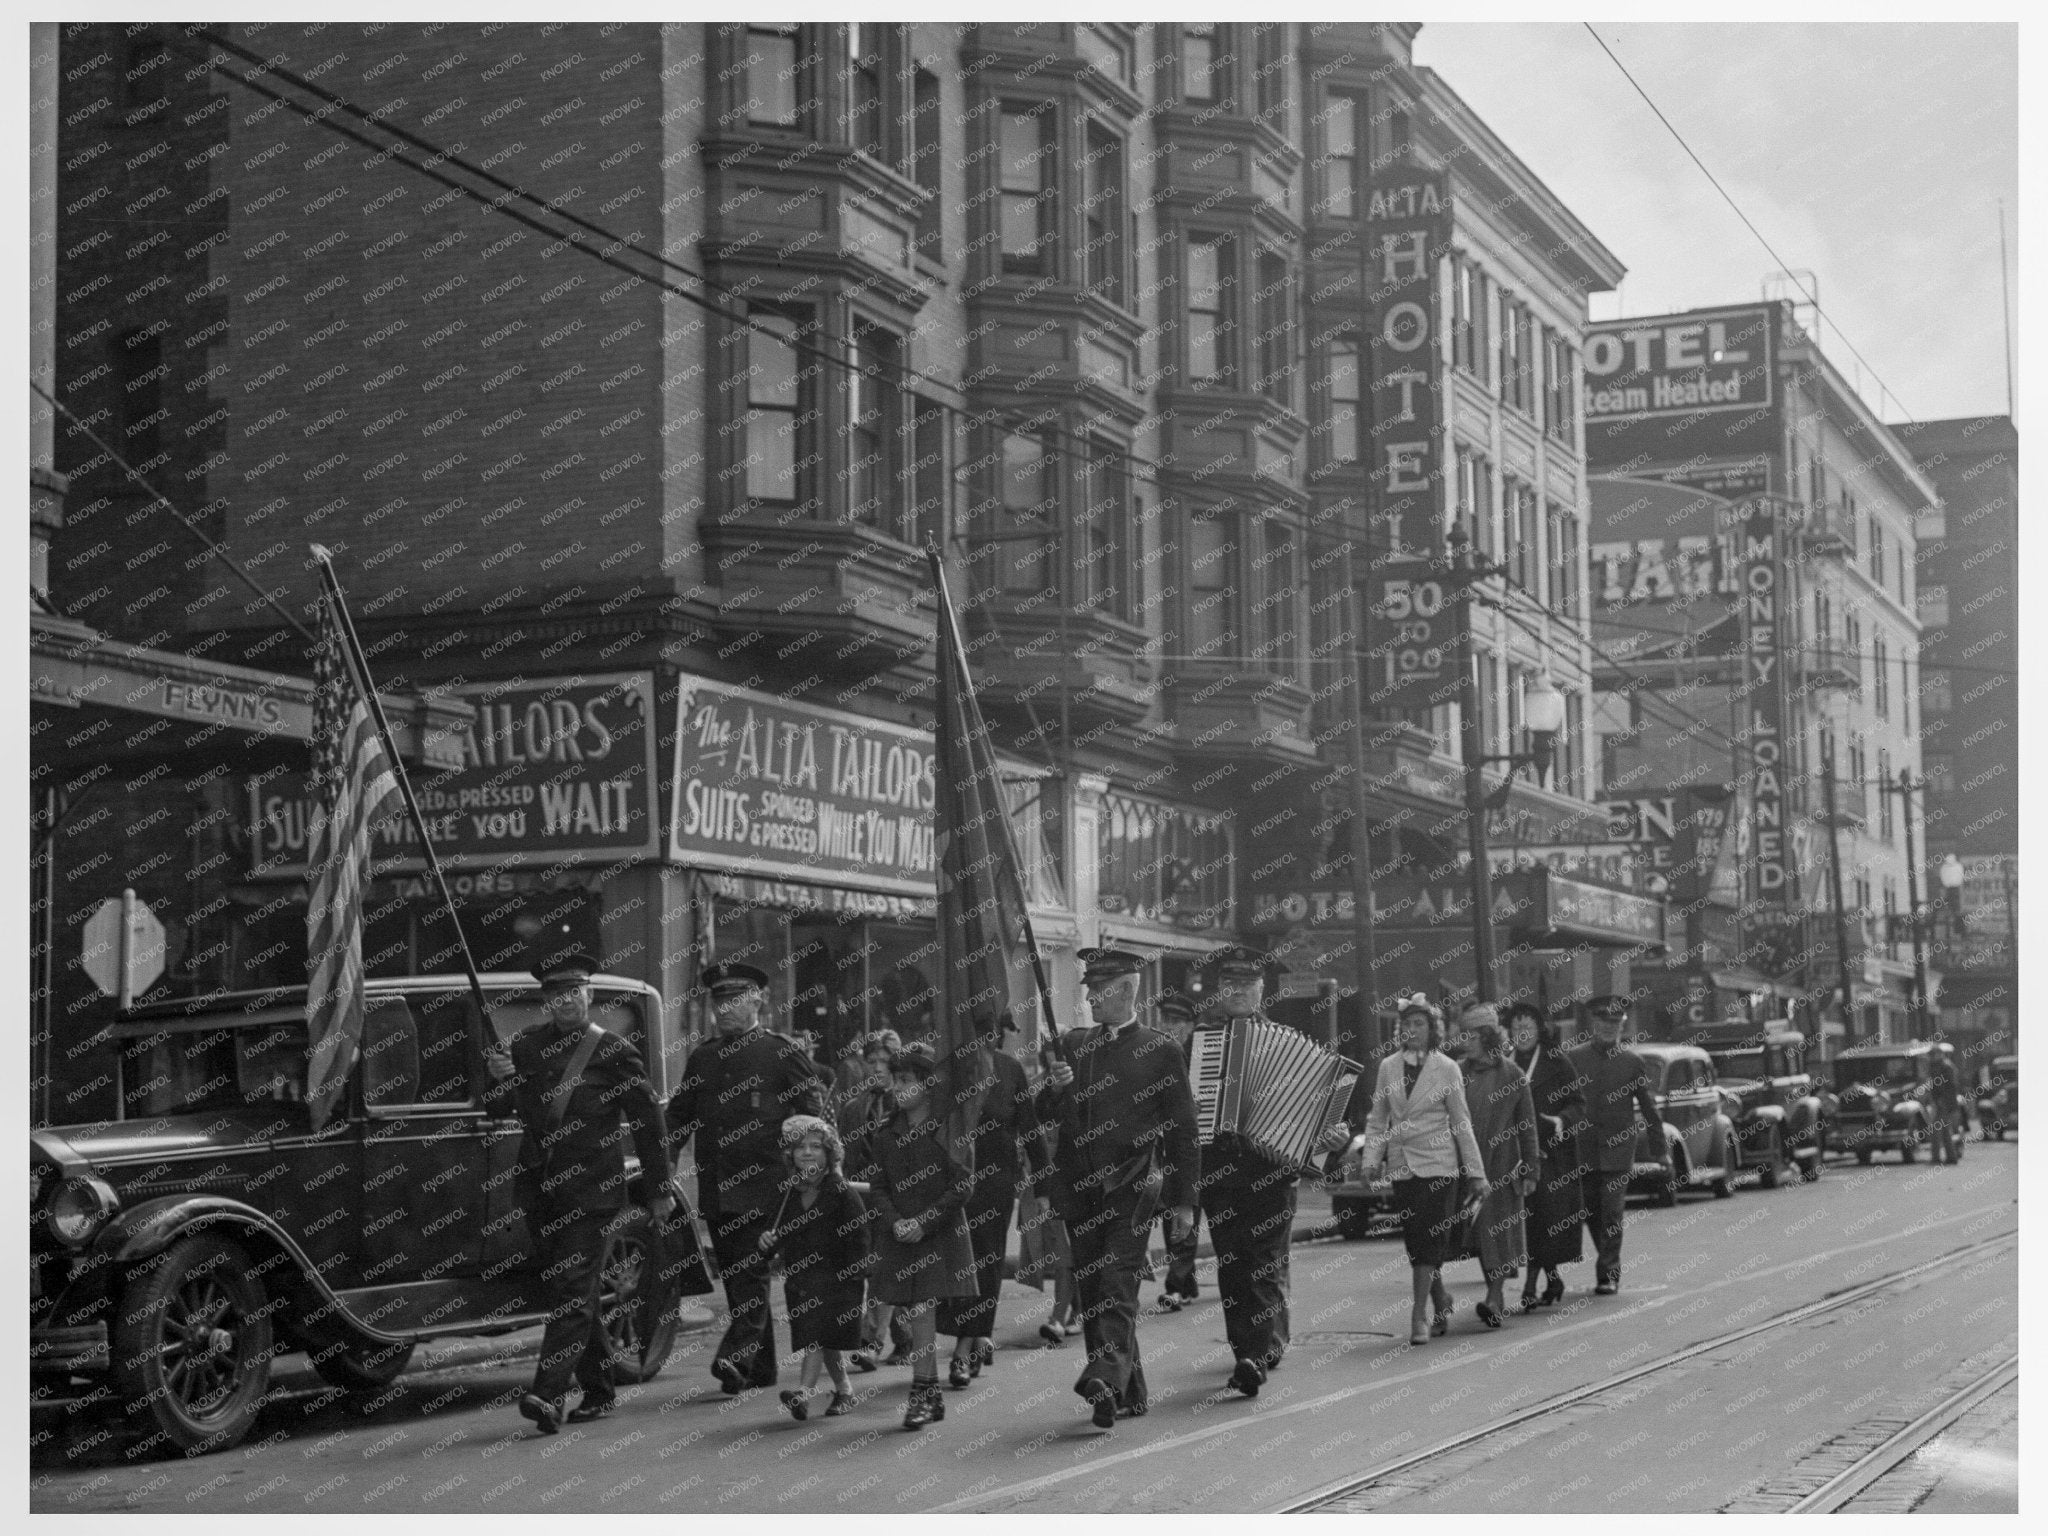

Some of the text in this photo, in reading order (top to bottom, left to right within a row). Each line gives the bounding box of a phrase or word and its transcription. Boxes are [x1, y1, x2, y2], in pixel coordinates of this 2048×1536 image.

[1368, 183, 1441, 222] ALTA
[1381, 230, 1431, 563] HOTEL
[1654, 369, 1741, 408] Heated
[1392, 620, 1431, 644] TO
[163, 683, 277, 724] FLYNN'S
[1747, 535, 1784, 889] MONEY LOANED
[695, 705, 935, 810] The ALTA TAILORS
[472, 813, 526, 839] YOU
[540, 780, 632, 836] WAIT
[684, 778, 750, 843] SUITS
[761, 790, 814, 823] SPONGED
[818, 801, 863, 862] WHILE
[866, 810, 896, 865] YOU
[391, 874, 513, 898] TAIORS
[1254, 886, 1517, 921] HOTEL ALA
